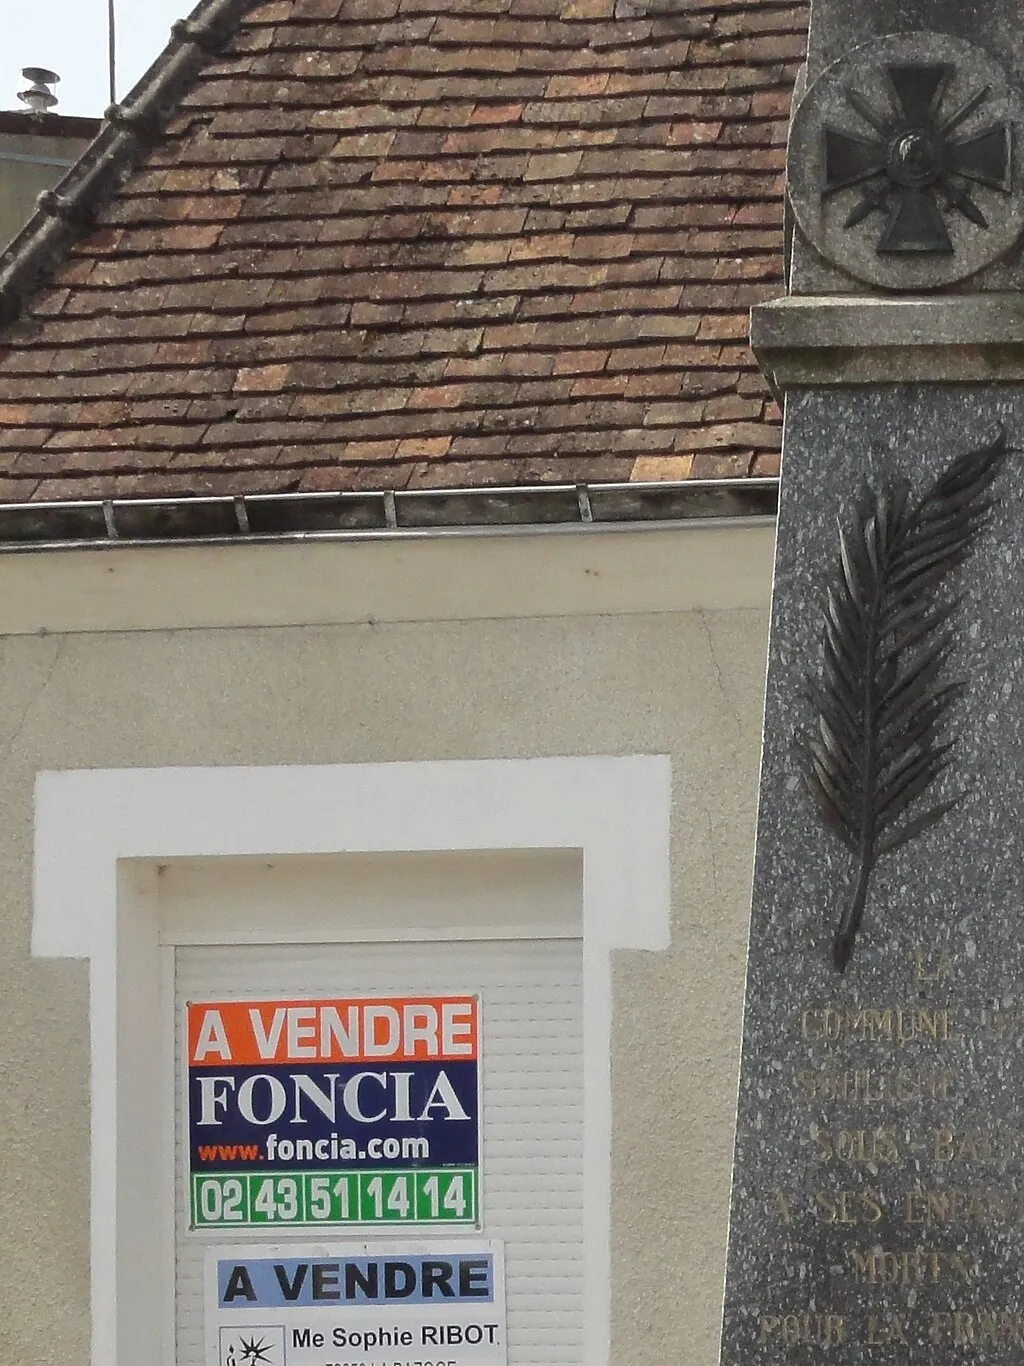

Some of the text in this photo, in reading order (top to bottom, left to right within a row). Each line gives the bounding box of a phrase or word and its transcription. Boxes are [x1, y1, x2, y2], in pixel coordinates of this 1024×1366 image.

[193, 1003, 473, 1061] A VENDRE
[800, 1007, 963, 1043] COMMUNE
[195, 1070, 471, 1125] FONCIA
[198, 1133, 429, 1161] www.foncia.com
[201, 1175, 466, 1220] 02 43 51 14 14
[813, 1191, 883, 1224] SES
[223, 1260, 489, 1302] A VENDRE
[292, 1328, 325, 1348] Me
[332, 1327, 413, 1351] Sophie
